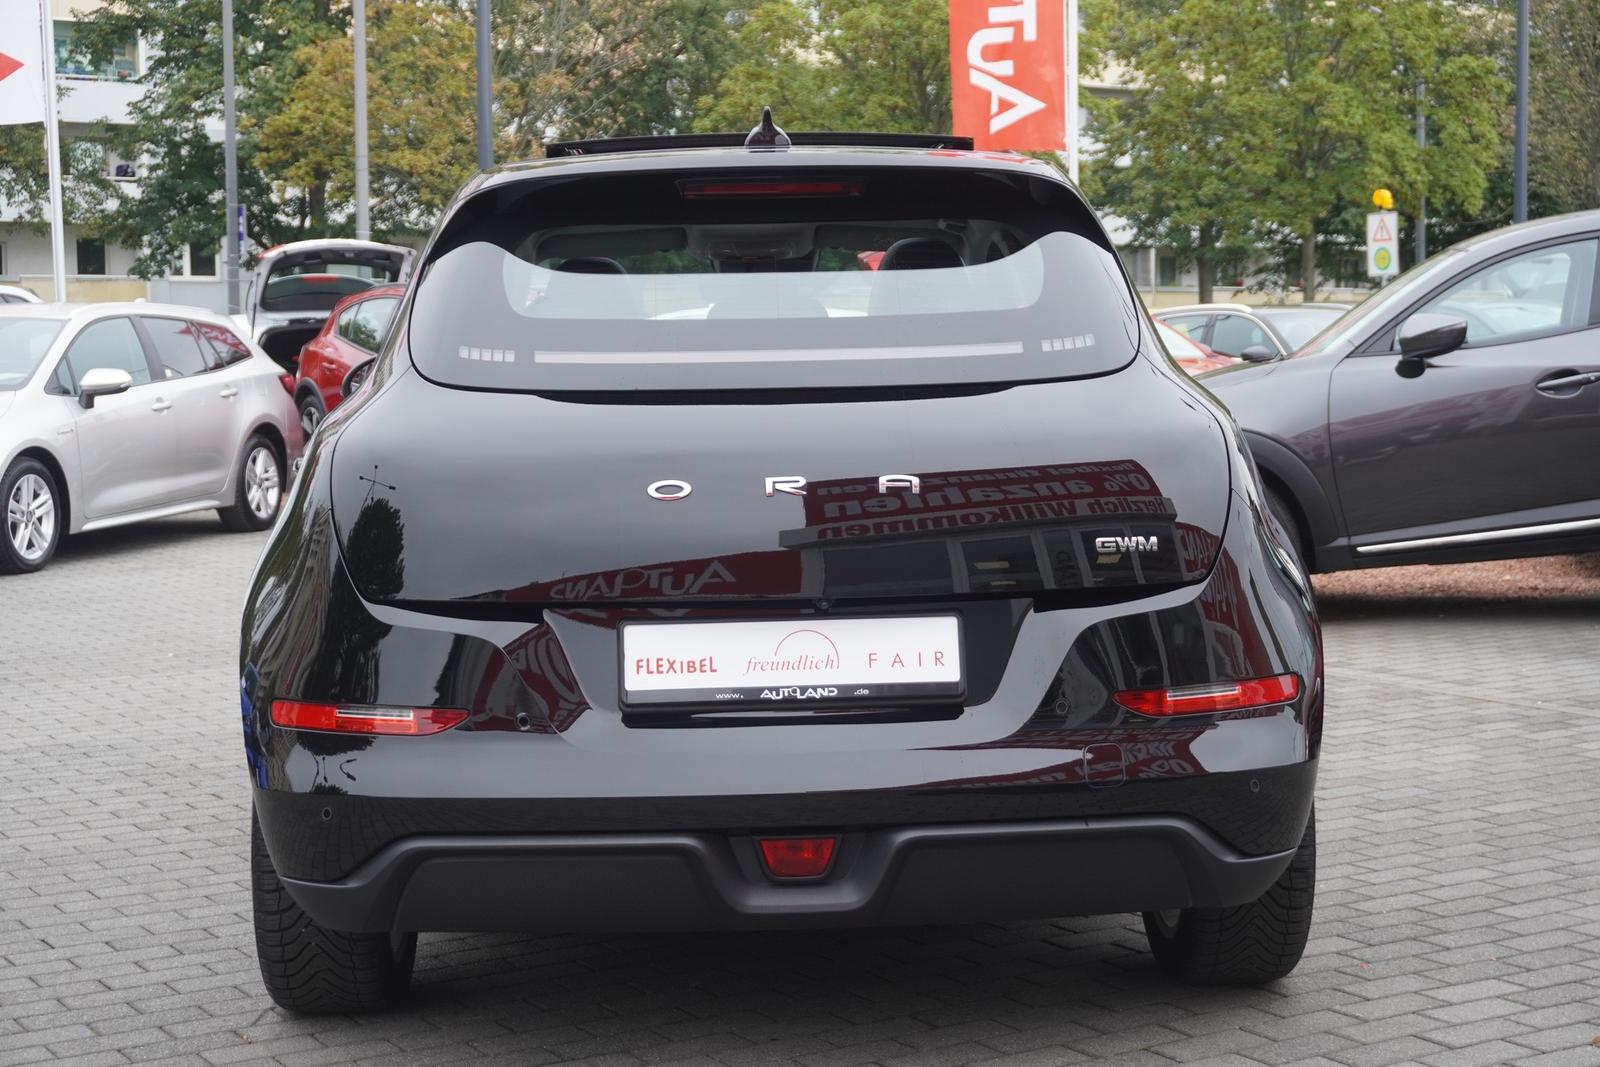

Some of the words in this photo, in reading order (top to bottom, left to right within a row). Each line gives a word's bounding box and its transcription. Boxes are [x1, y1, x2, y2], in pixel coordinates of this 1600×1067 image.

[647, 474, 921, 501] ORA
[1095, 536, 1158, 553] GWM
[635, 655, 718, 675] FLEXIBEL
[743, 654, 837, 676] freundlich
[867, 650, 946, 669] FAIR
